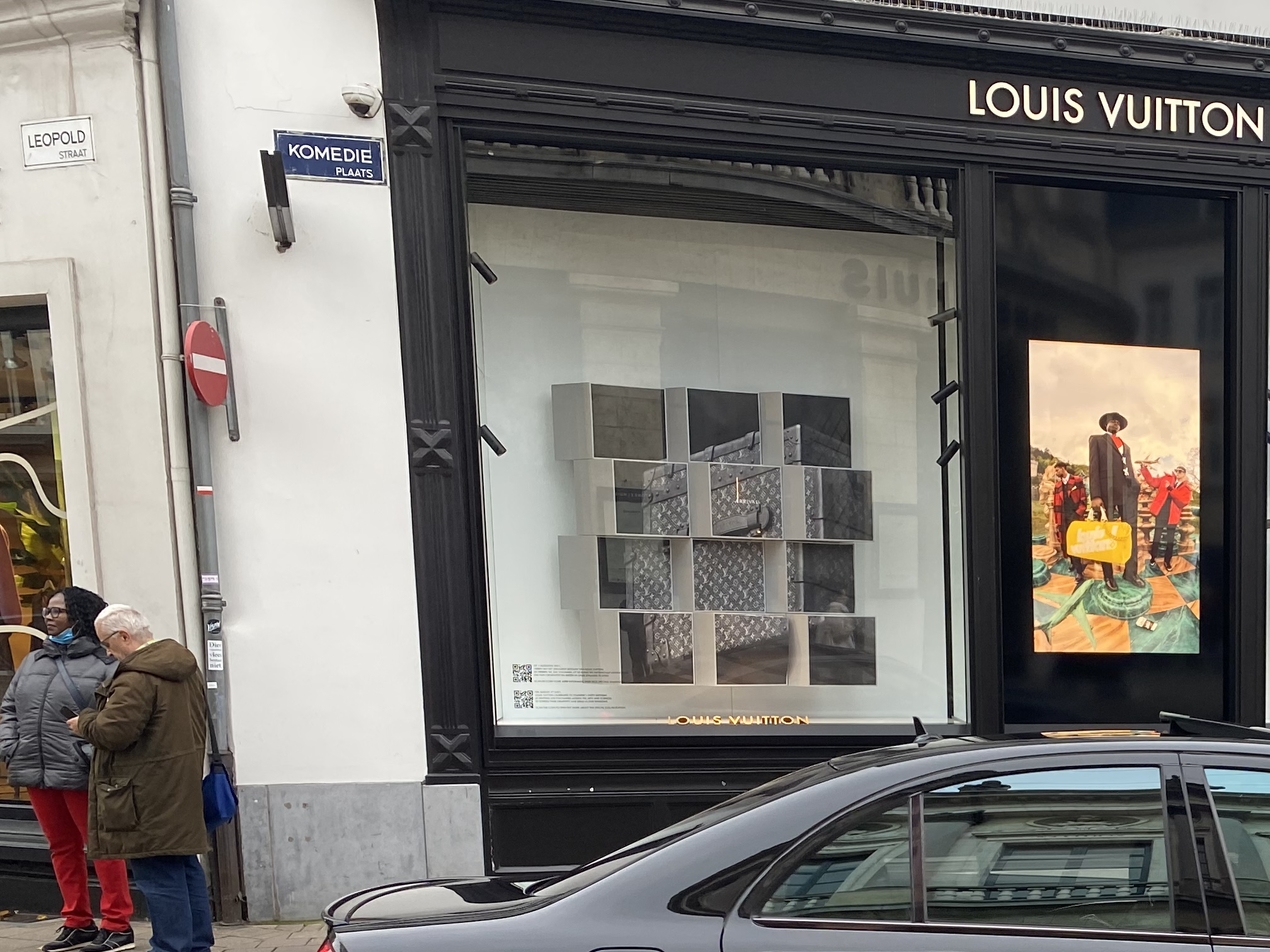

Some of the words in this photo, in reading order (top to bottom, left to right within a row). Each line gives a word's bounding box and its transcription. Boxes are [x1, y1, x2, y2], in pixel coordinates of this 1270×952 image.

[969, 79, 1085, 124] LOUIS
[1098, 91, 1264, 142] VUITTON
[27, 129, 86, 149] LEOPOLD
[58, 148, 88, 160] STRAAT
[288, 143, 373, 164] KOMEDIE
[335, 166, 374, 178] PLAATS
[668, 715, 722, 725] LOUIS
[728, 715, 810, 725] VUITTON
